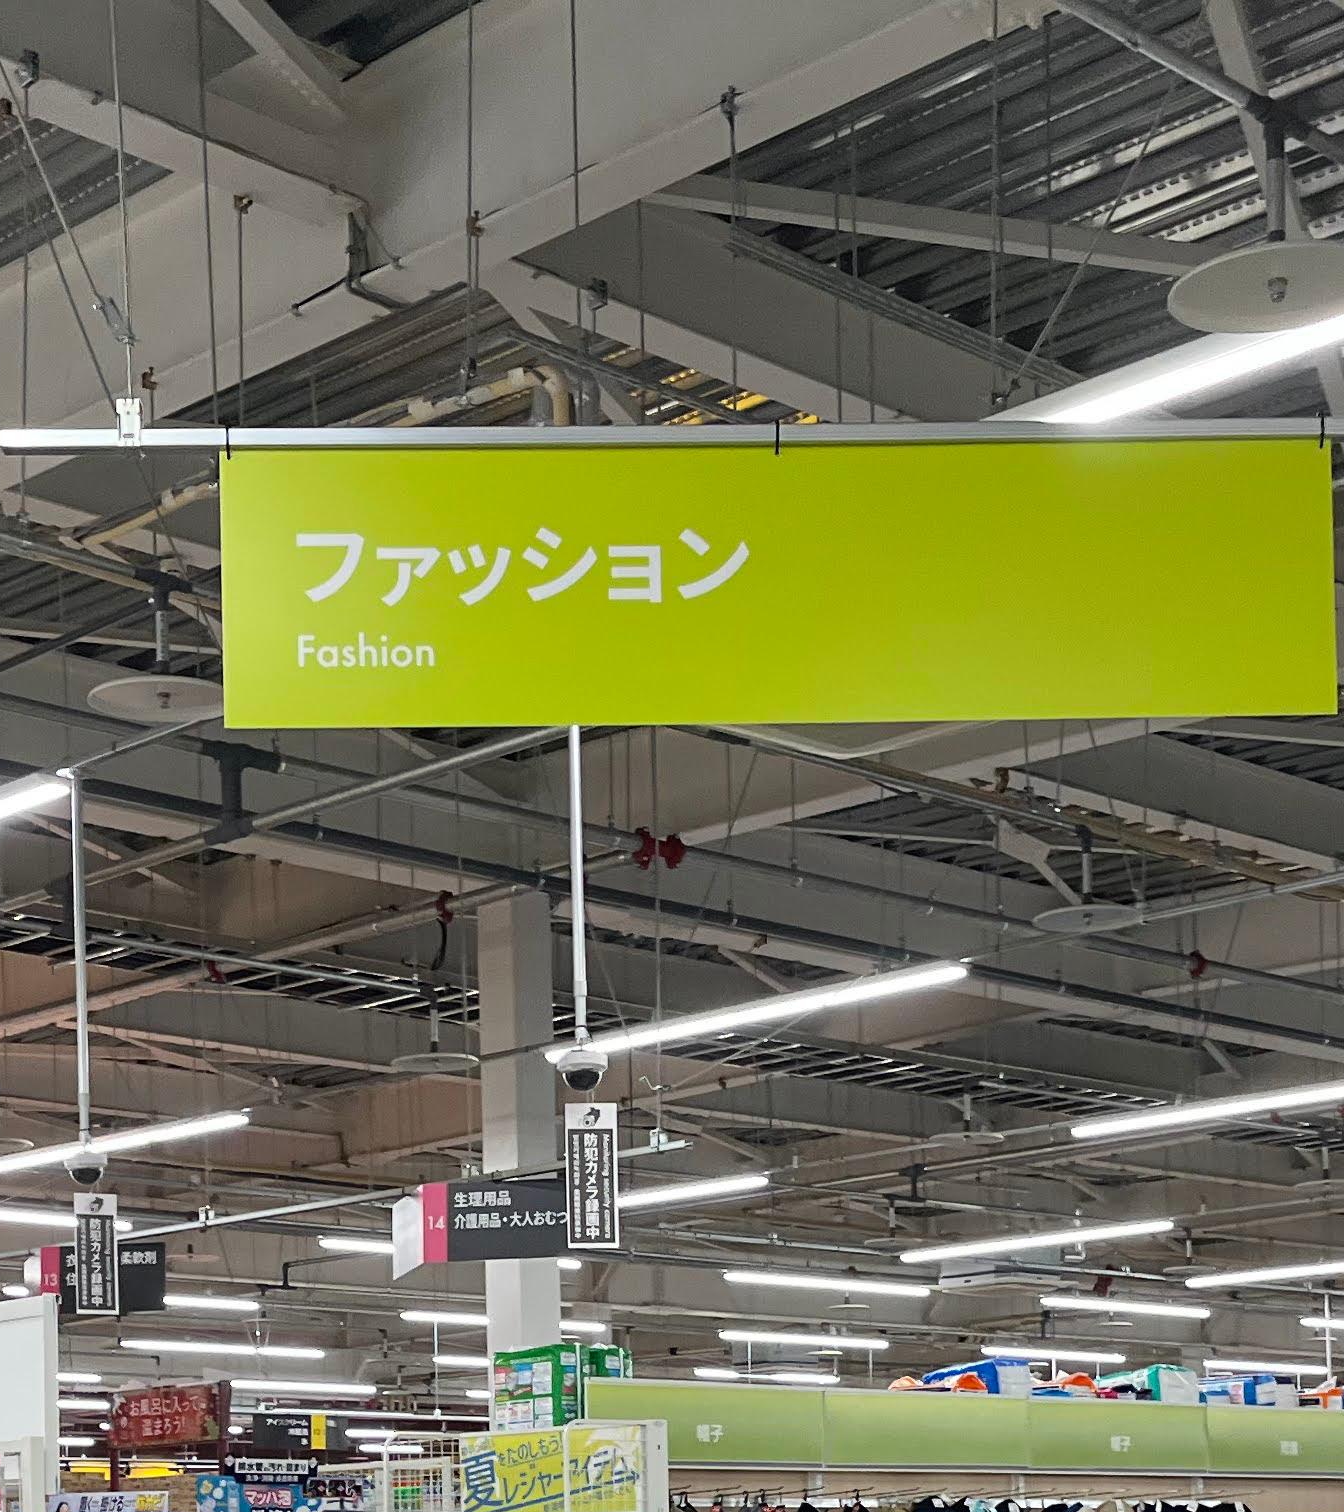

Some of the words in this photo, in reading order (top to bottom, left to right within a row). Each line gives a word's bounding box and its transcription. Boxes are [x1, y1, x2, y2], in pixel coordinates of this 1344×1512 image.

[296, 527, 750, 607] ファッション
[297, 634, 436, 669] Fashion
[453, 1190, 512, 1208] 生理用品
[583, 1132, 600, 1240] 防犯カメラ録画中
[428, 1216, 446, 1231] 14
